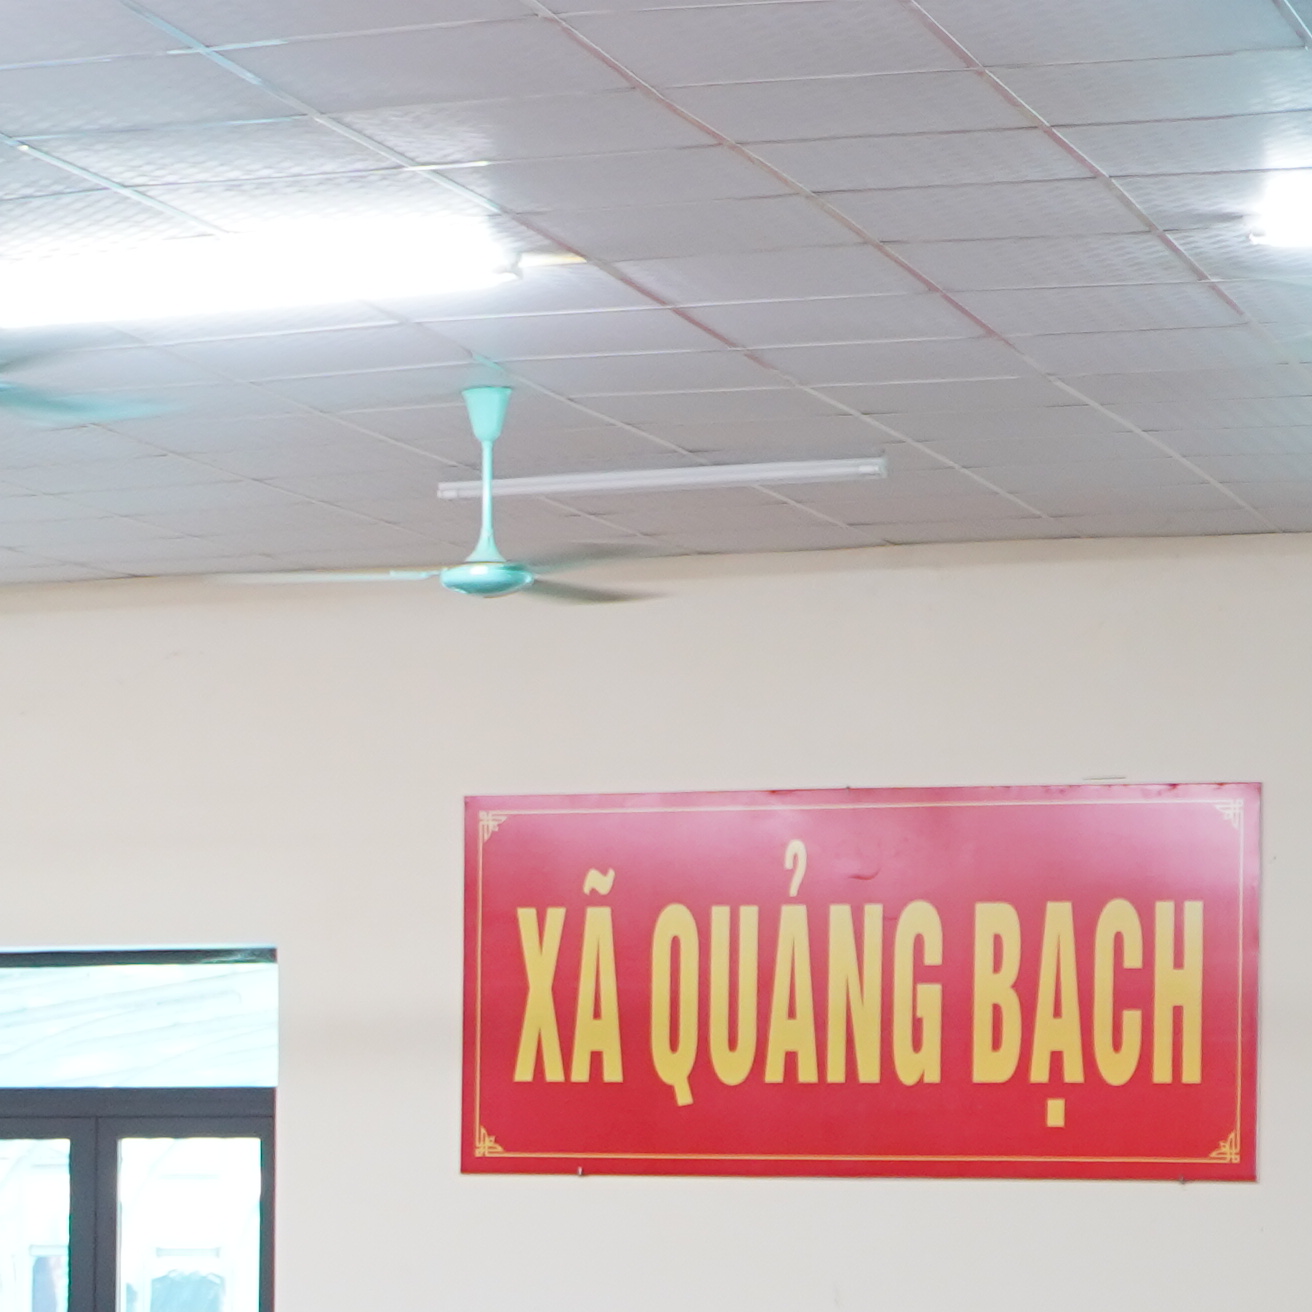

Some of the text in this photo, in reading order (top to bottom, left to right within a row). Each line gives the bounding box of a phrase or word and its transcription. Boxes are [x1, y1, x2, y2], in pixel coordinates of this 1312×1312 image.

[512, 839, 1205, 1128] XÃ QUẢNG BẠCH
